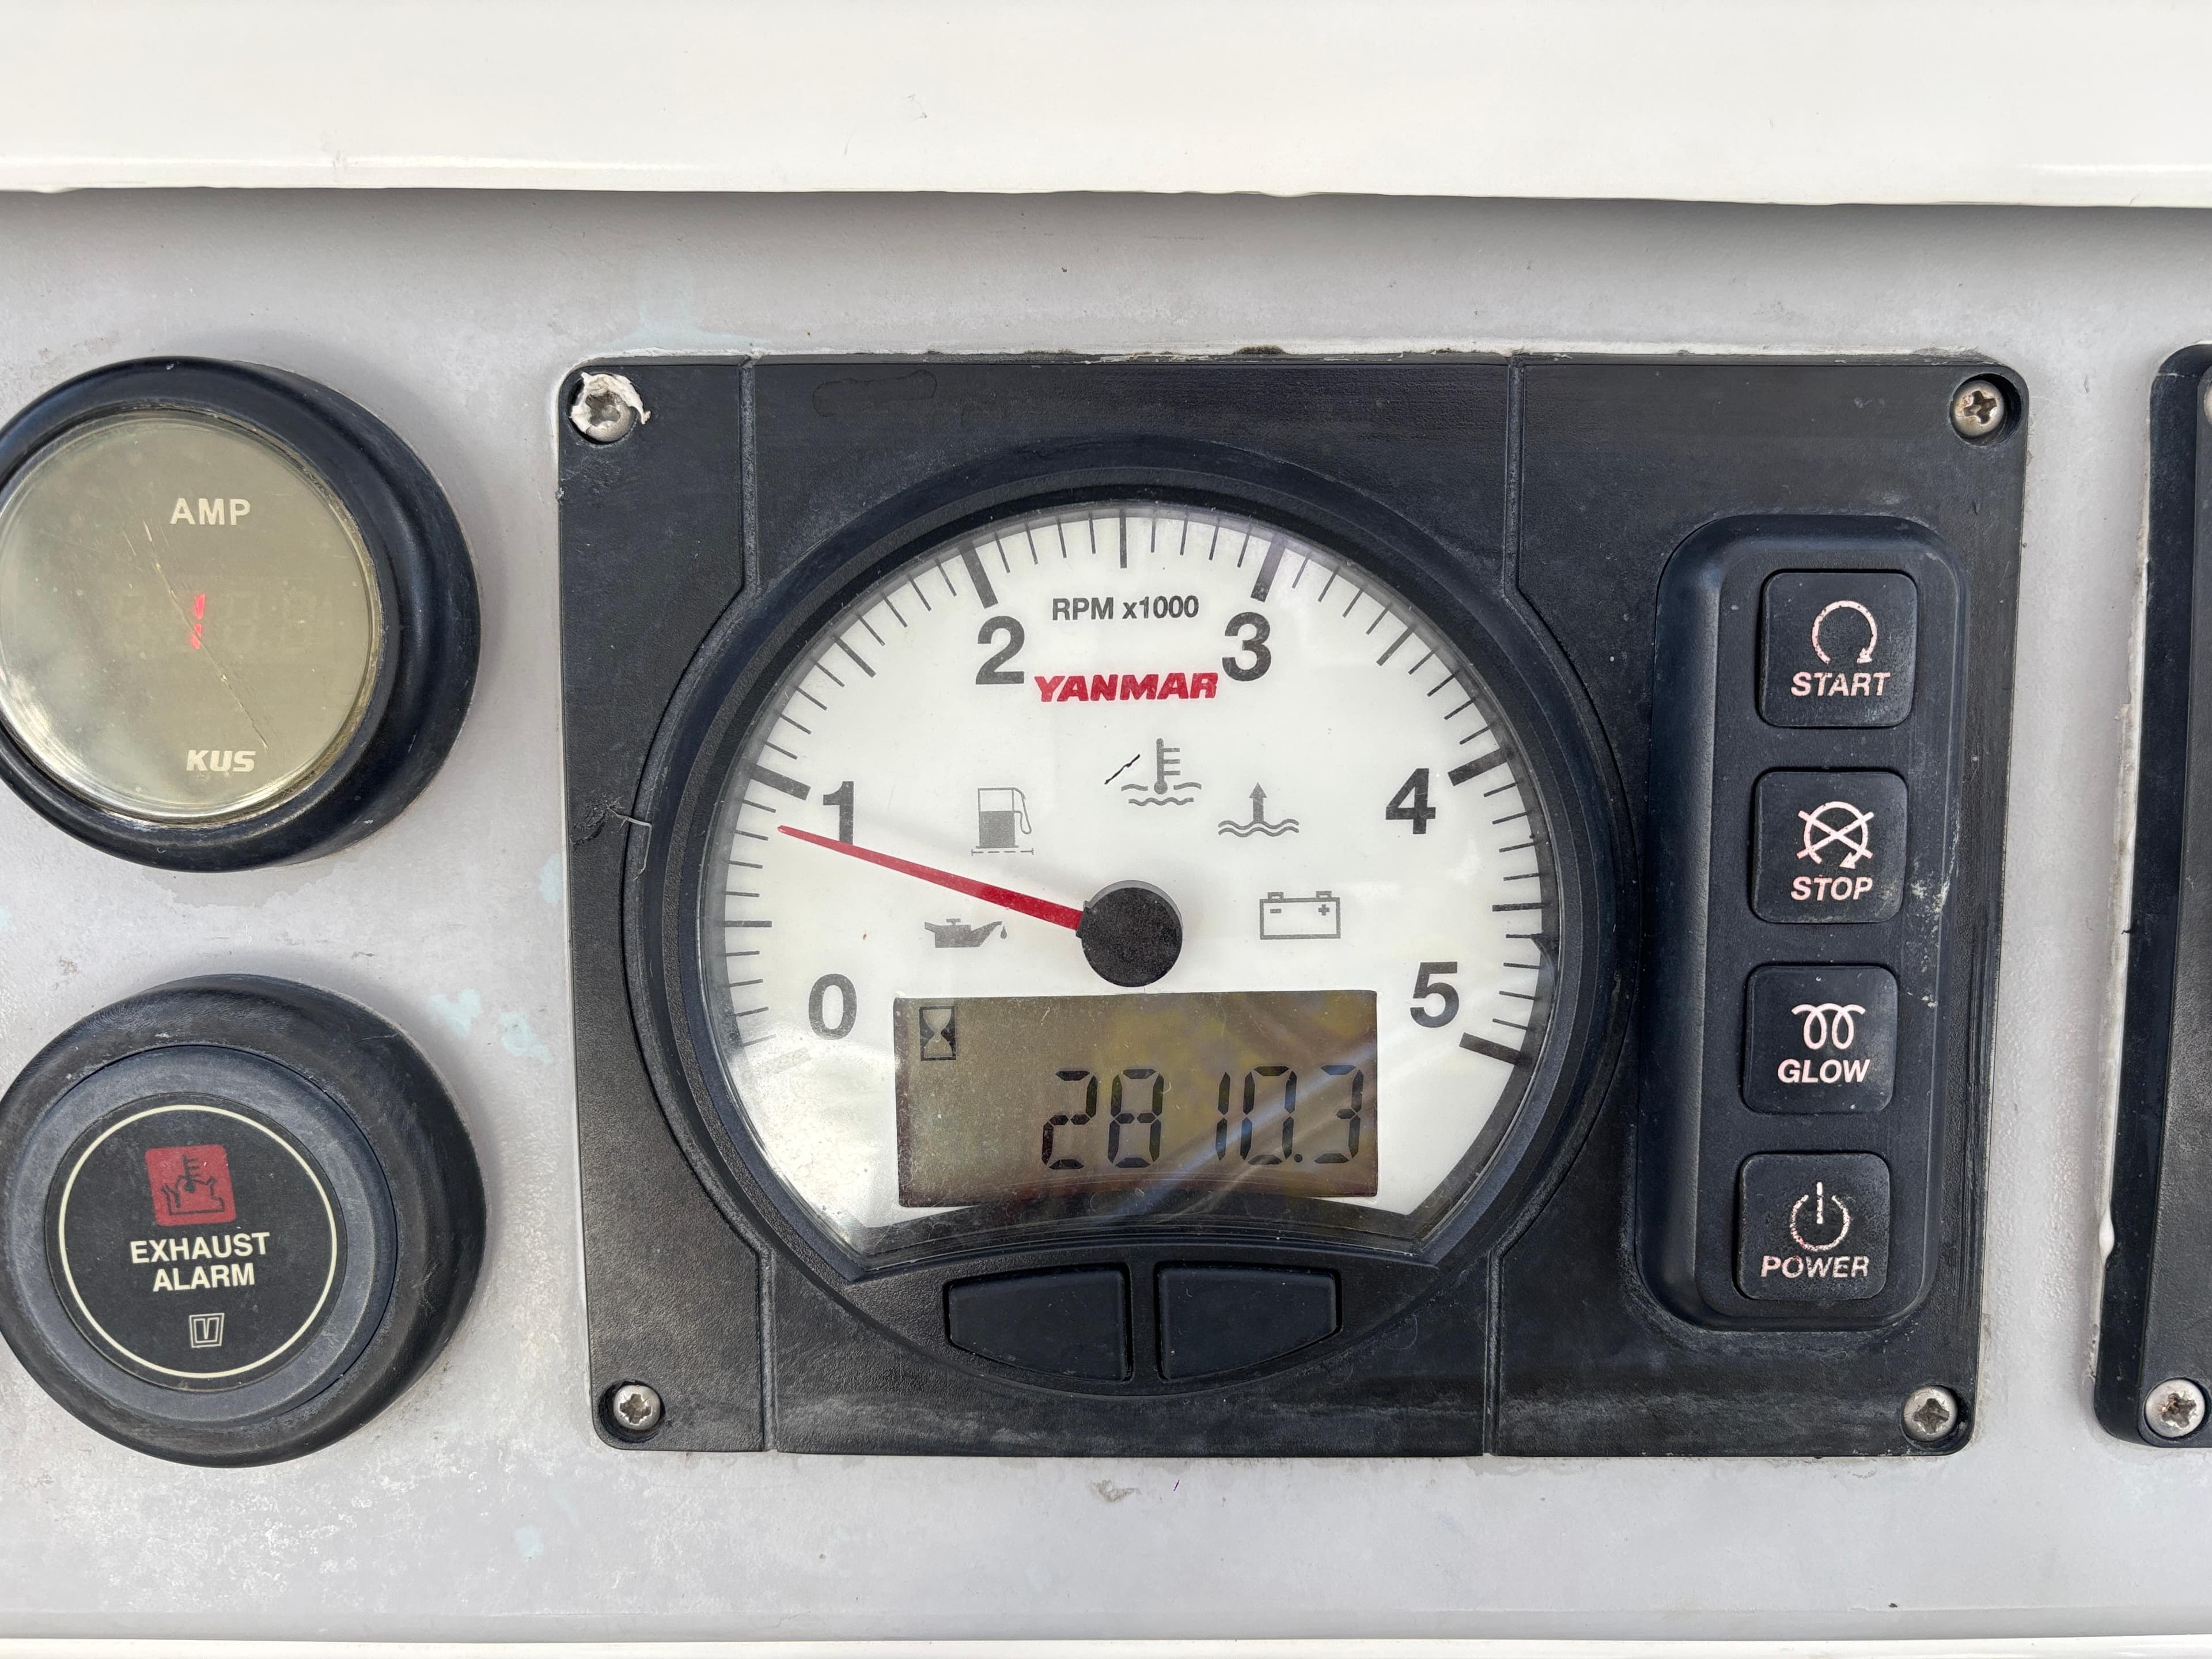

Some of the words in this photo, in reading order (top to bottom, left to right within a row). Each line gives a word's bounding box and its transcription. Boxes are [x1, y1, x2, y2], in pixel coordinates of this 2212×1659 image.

[170, 498, 251, 525] AMP
[1052, 597, 1114, 620] RPM
[1122, 595, 1199, 619] x1000
[975, 615, 1025, 685] 2
[1221, 611, 1272, 682] 3
[1034, 672, 1218, 702] YANMAR
[1790, 671, 1891, 697] START
[186, 749, 256, 772] KUS
[823, 781, 854, 844] 1
[1385, 768, 1436, 835] 4
[1790, 876, 1874, 902] STOP
[808, 973, 857, 1040] 0
[1410, 961, 1460, 1028] 5
[1777, 1058, 1871, 1084] GLOW
[130, 1232, 270, 1264] EXHAUST
[153, 1262, 255, 1292] ALARM
[1760, 1255, 1869, 1279] POWER
